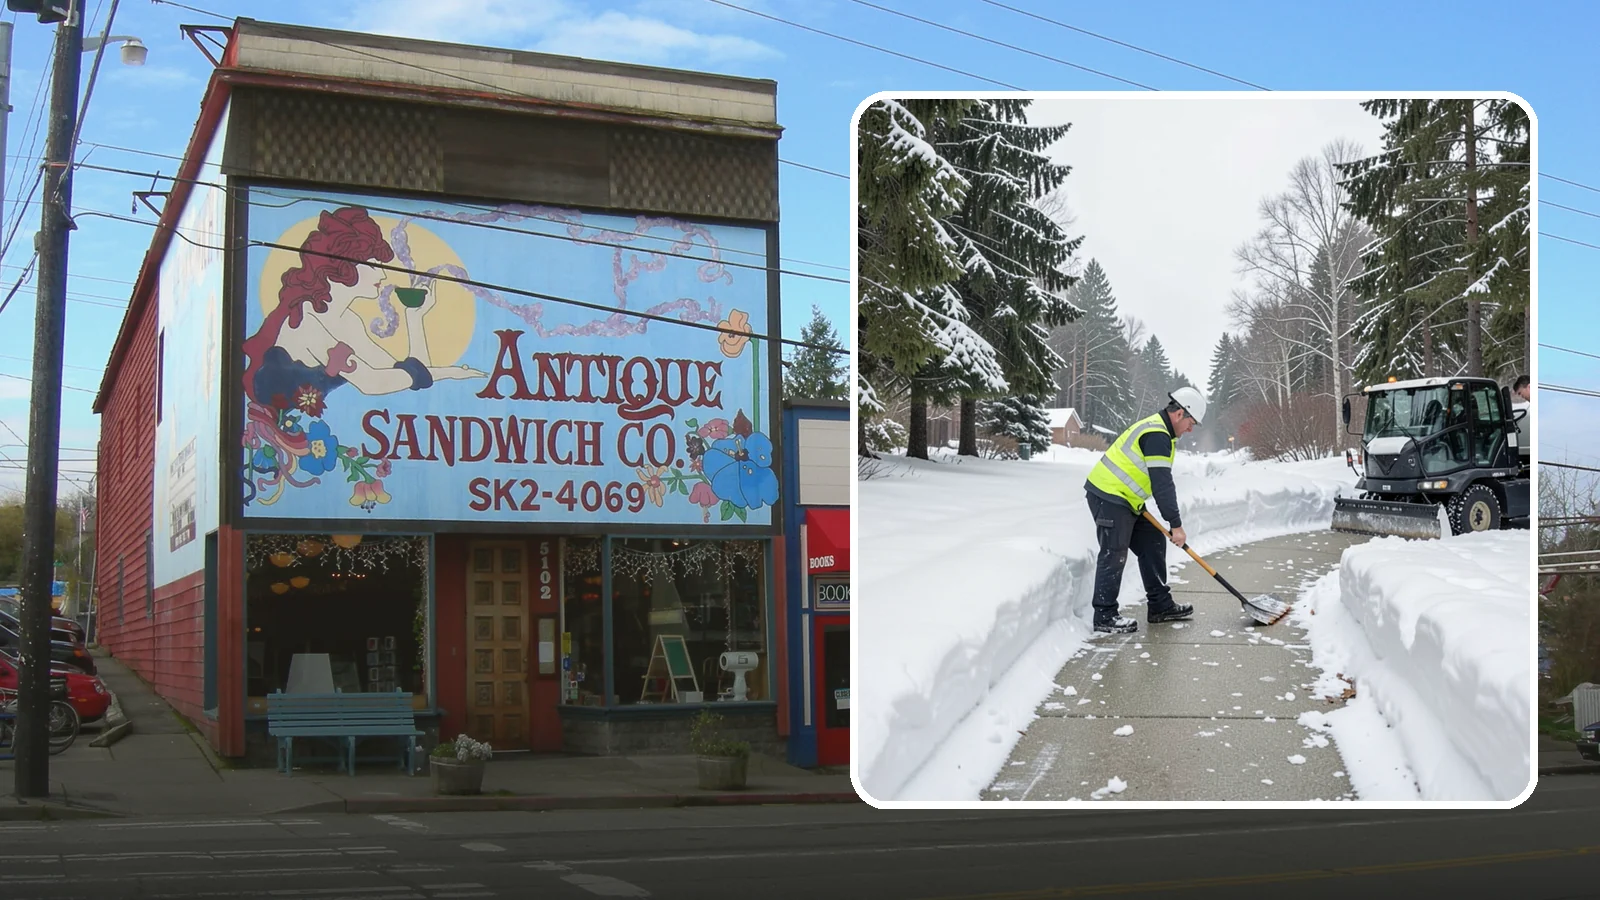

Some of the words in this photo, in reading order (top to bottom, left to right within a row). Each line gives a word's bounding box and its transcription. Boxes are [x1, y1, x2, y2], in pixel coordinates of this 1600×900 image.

[475, 329, 723, 421] ANTIQUE
[361, 409, 605, 467] SANDWICH
[616, 422, 685, 469] CO.
[468, 477, 646, 513] SK2-4069
[540, 542, 552, 598] 5102
[809, 555, 834, 568] BOOKS
